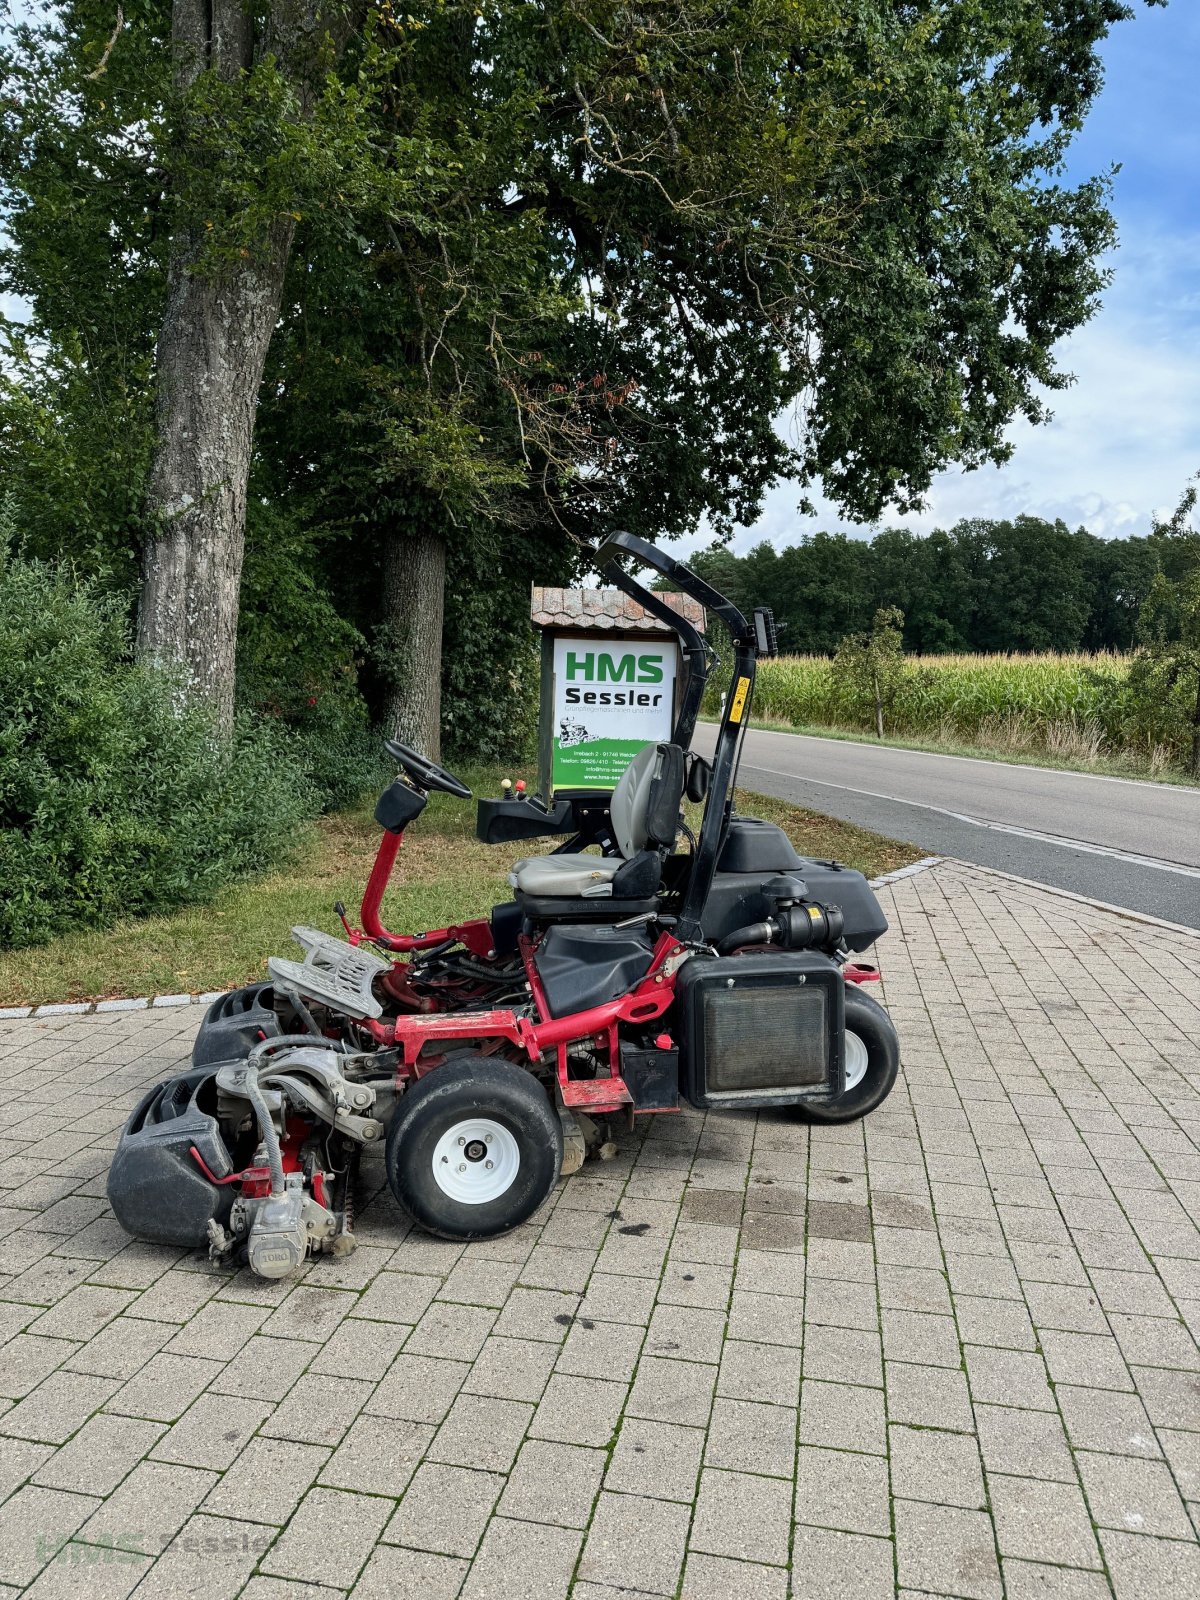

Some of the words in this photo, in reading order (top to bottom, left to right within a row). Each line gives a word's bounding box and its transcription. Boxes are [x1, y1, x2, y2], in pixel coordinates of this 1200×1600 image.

[566, 652, 663, 683] HMS
[565, 688, 662, 706] Sessler
[263, 1254, 287, 1262] TORO
